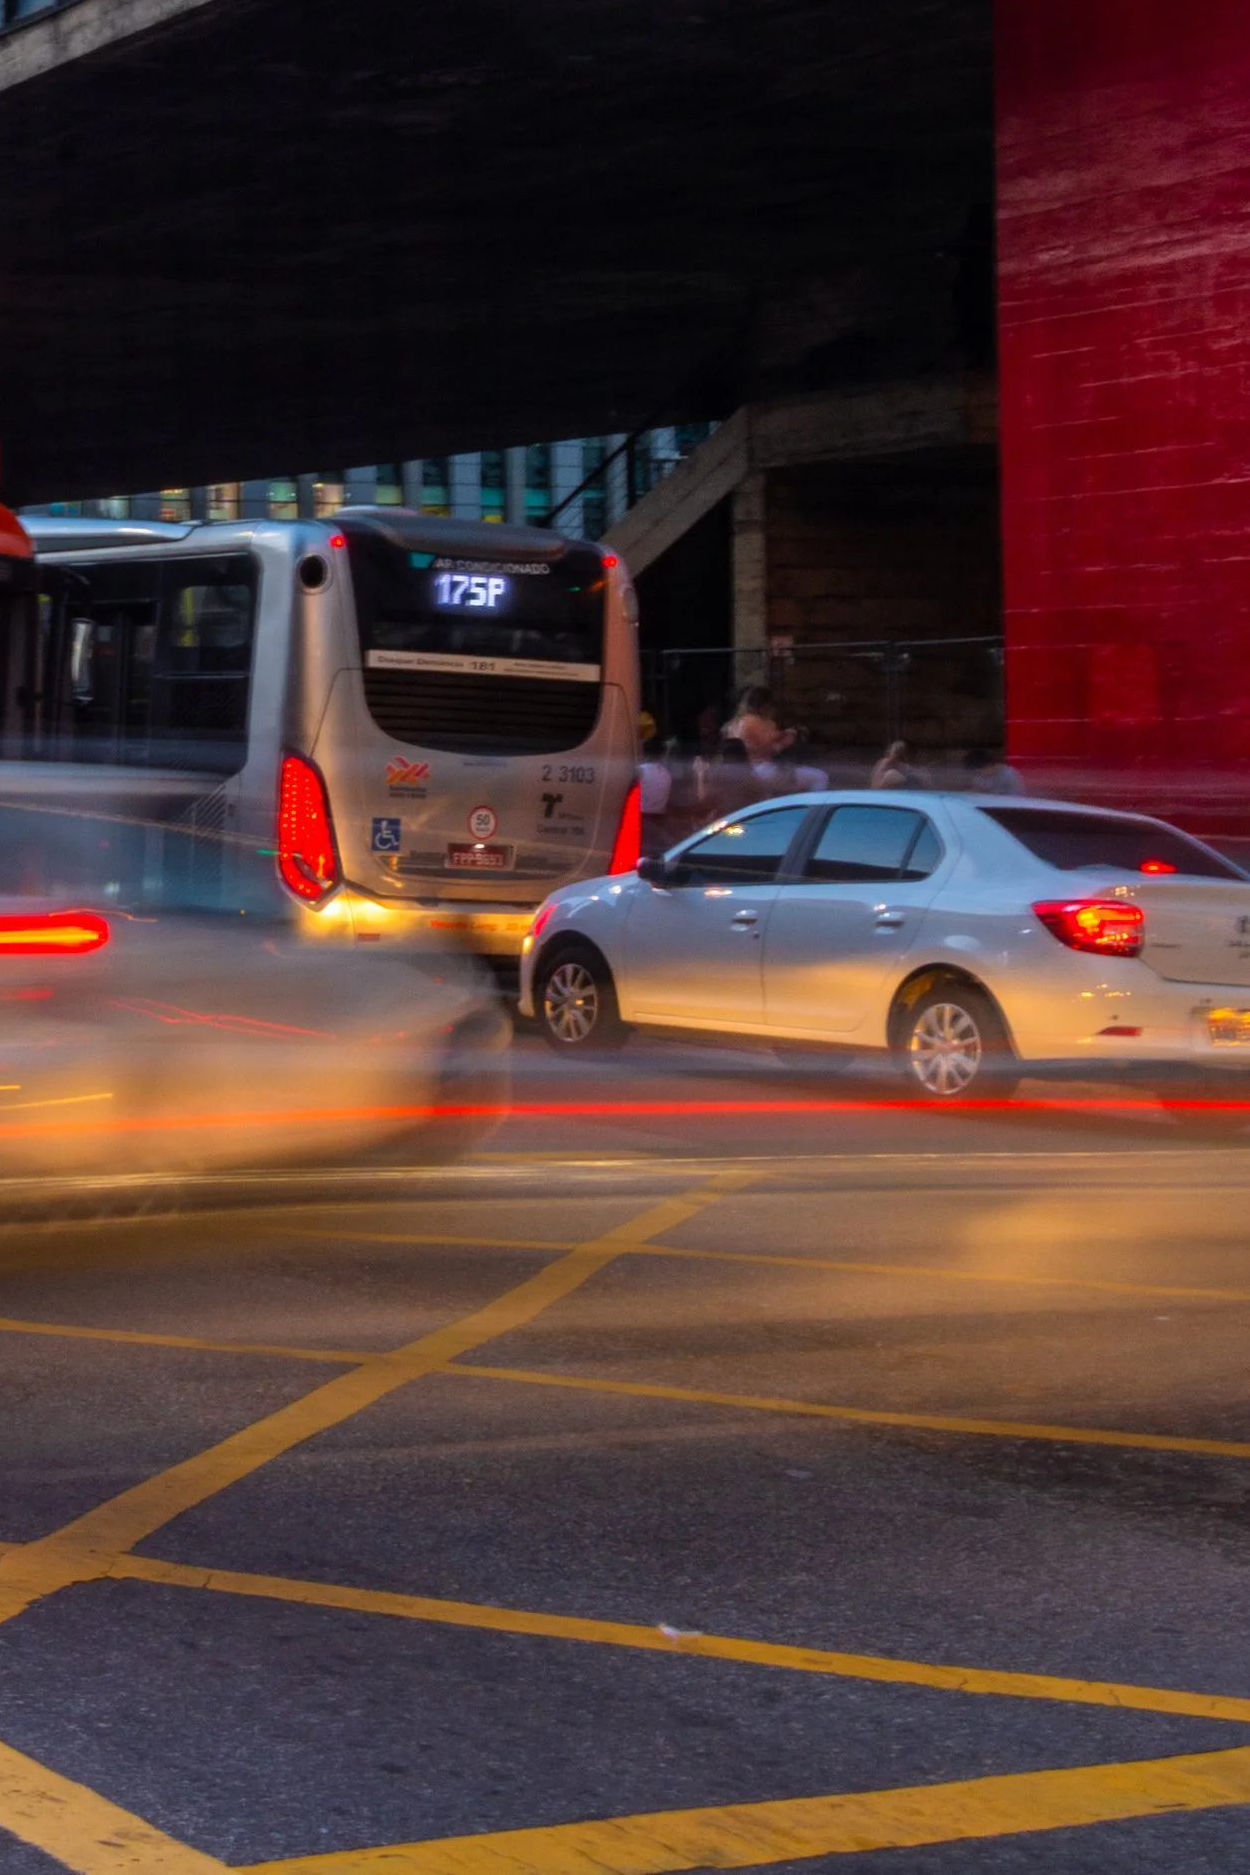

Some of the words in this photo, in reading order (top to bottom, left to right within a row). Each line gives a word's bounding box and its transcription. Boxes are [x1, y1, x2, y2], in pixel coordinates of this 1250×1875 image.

[434, 574, 507, 607] 175P
[541, 764, 552, 782] 2
[558, 765, 596, 785] 3103
[475, 813, 491, 826] 50
